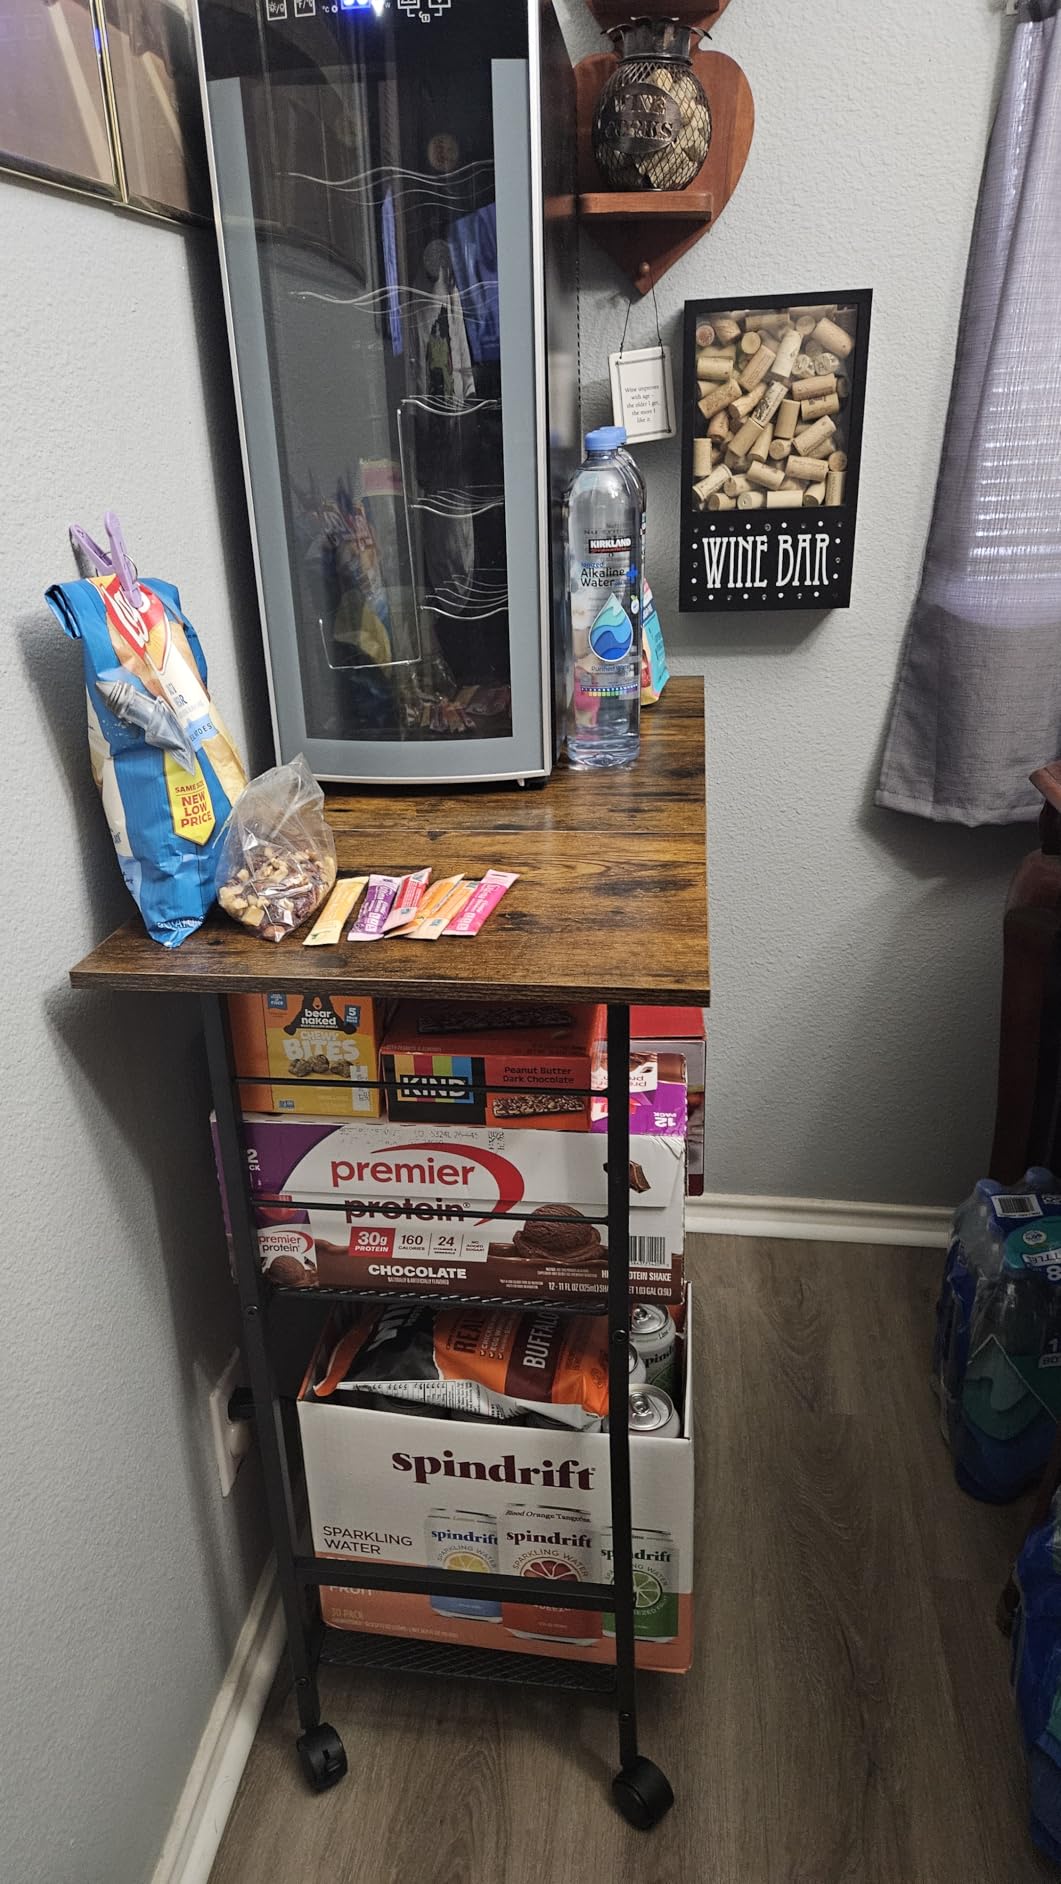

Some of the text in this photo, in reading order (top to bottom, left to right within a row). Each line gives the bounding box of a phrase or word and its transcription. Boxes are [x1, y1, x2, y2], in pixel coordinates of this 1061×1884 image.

[590, 538, 631, 549] KIRKLAND
[702, 533, 830, 589] WINE BAR
[581, 568, 625, 578] Alkaline
[581, 577, 615, 588] Water
[175, 783, 196, 794] SAME
[181, 790, 206, 807] NEW
[184, 801, 207, 817] LOW
[180, 810, 212, 828] PRICE
[304, 1008, 332, 1019] bear
[348, 1007, 357, 1016] 5
[301, 1016, 337, 1025] naked
[300, 1031, 340, 1040] CHEWY
[282, 1038, 360, 1062] BITES
[504, 1066, 572, 1075] Peanut Butter
[402, 1077, 467, 1097] KIND
[503, 1075, 575, 1084] Dark Chocolate
[654, 1117, 677, 1127] 12
[247, 1148, 259, 1163] 2
[330, 1157, 476, 1188] premier
[344, 1198, 465, 1224] protein
[259, 1234, 302, 1245] premier
[357, 1231, 388, 1245] 30g
[400, 1234, 424, 1246] 160
[437, 1235, 455, 1247] 24
[262, 1243, 299, 1253] protein
[368, 1264, 467, 1280] CHOCOLATE
[649, 1272, 672, 1282] SHAKE
[548, 1282, 555, 1291] 12
[522, 1311, 560, 1369] BUFFALO
[391, 1450, 595, 1490] spindrift
[526, 1510, 555, 1519] Orange
[323, 1525, 413, 1547] SPARKLING
[431, 1529, 498, 1546] spindrift
[506, 1530, 592, 1549] spindrift
[324, 1538, 381, 1555] WATER
[437, 1545, 473, 1561] SPARKLING
[512, 1549, 589, 1577] SPARKLING WATER
[601, 1548, 672, 1563] spdrift
[647, 1565, 669, 1586] WATER
